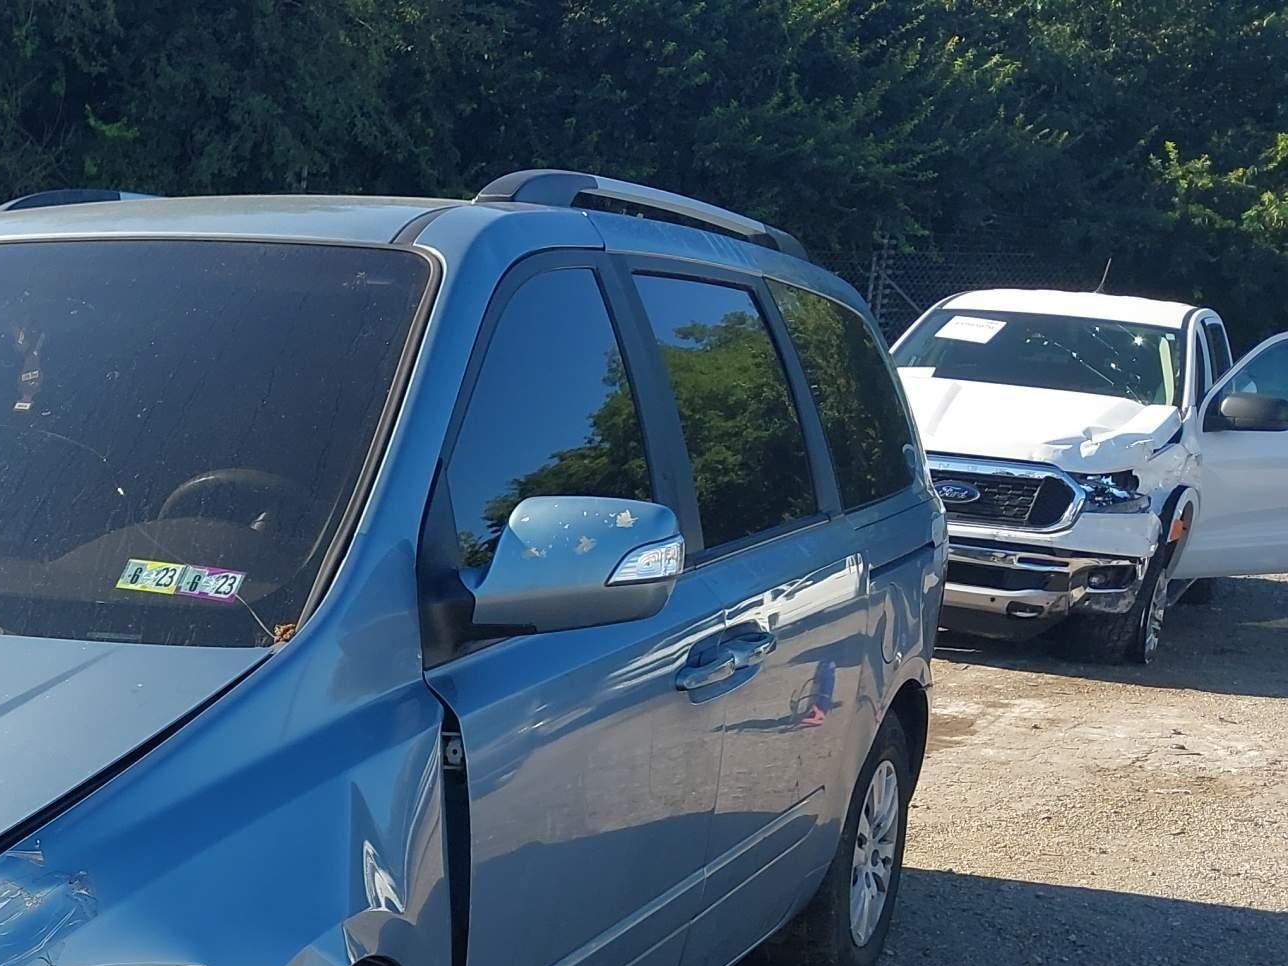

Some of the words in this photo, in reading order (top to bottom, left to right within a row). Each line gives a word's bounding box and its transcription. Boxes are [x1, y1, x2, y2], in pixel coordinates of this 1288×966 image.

[939, 485, 968, 499] Ford
[155, 567, 177, 588] 23
[214, 574, 237, 596] 23
